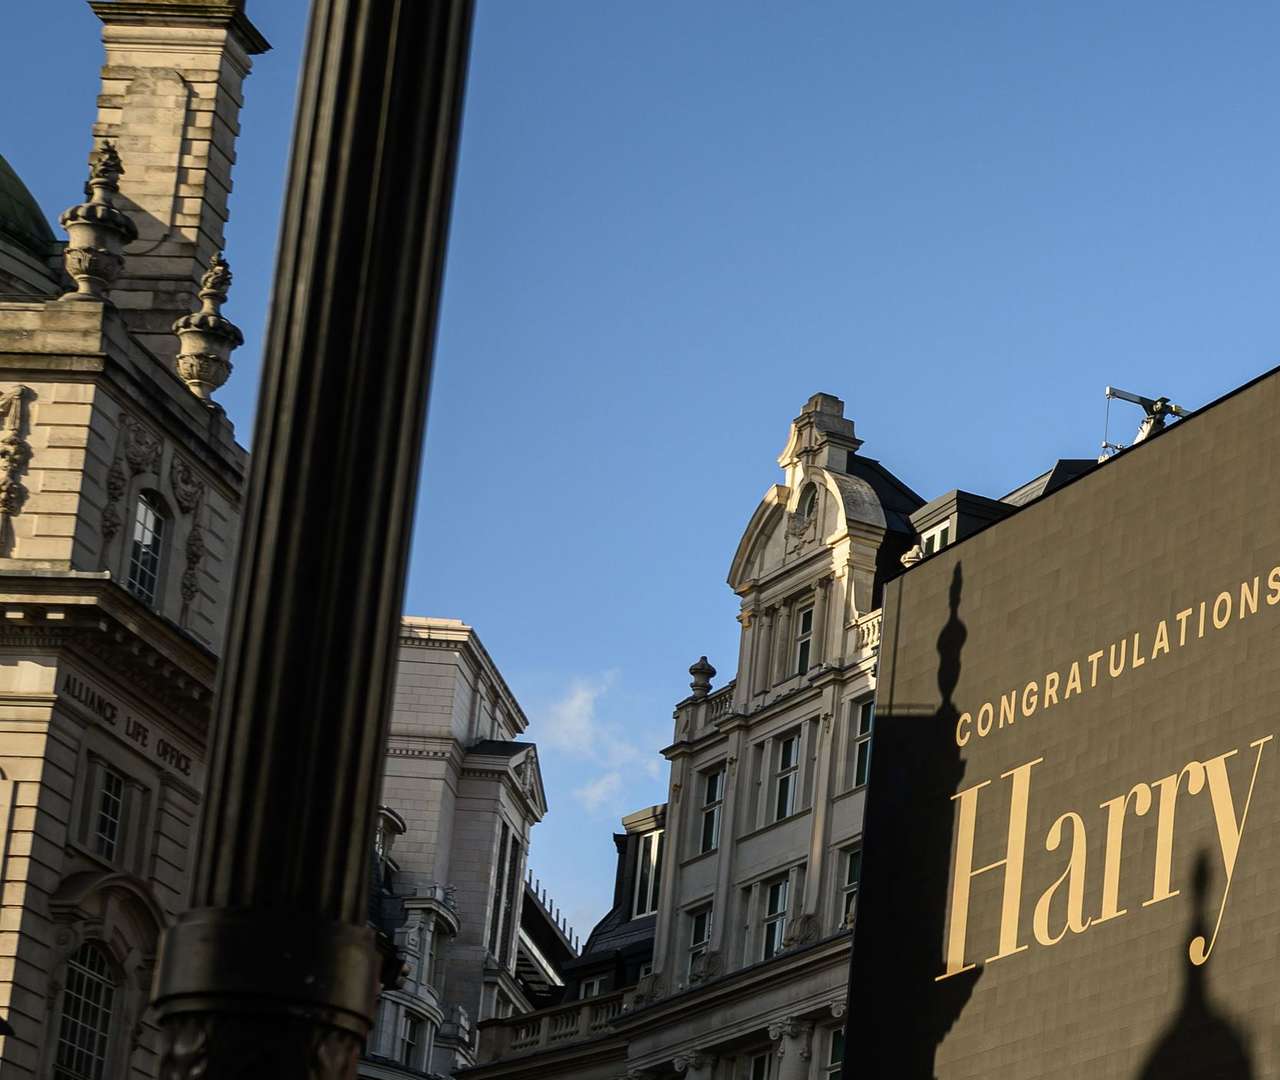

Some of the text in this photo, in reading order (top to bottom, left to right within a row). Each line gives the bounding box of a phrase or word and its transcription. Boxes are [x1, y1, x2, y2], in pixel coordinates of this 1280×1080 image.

[62, 674, 193, 776] ALLIANCE LIFE OFFICE
[934, 734, 1274, 982] Harry
